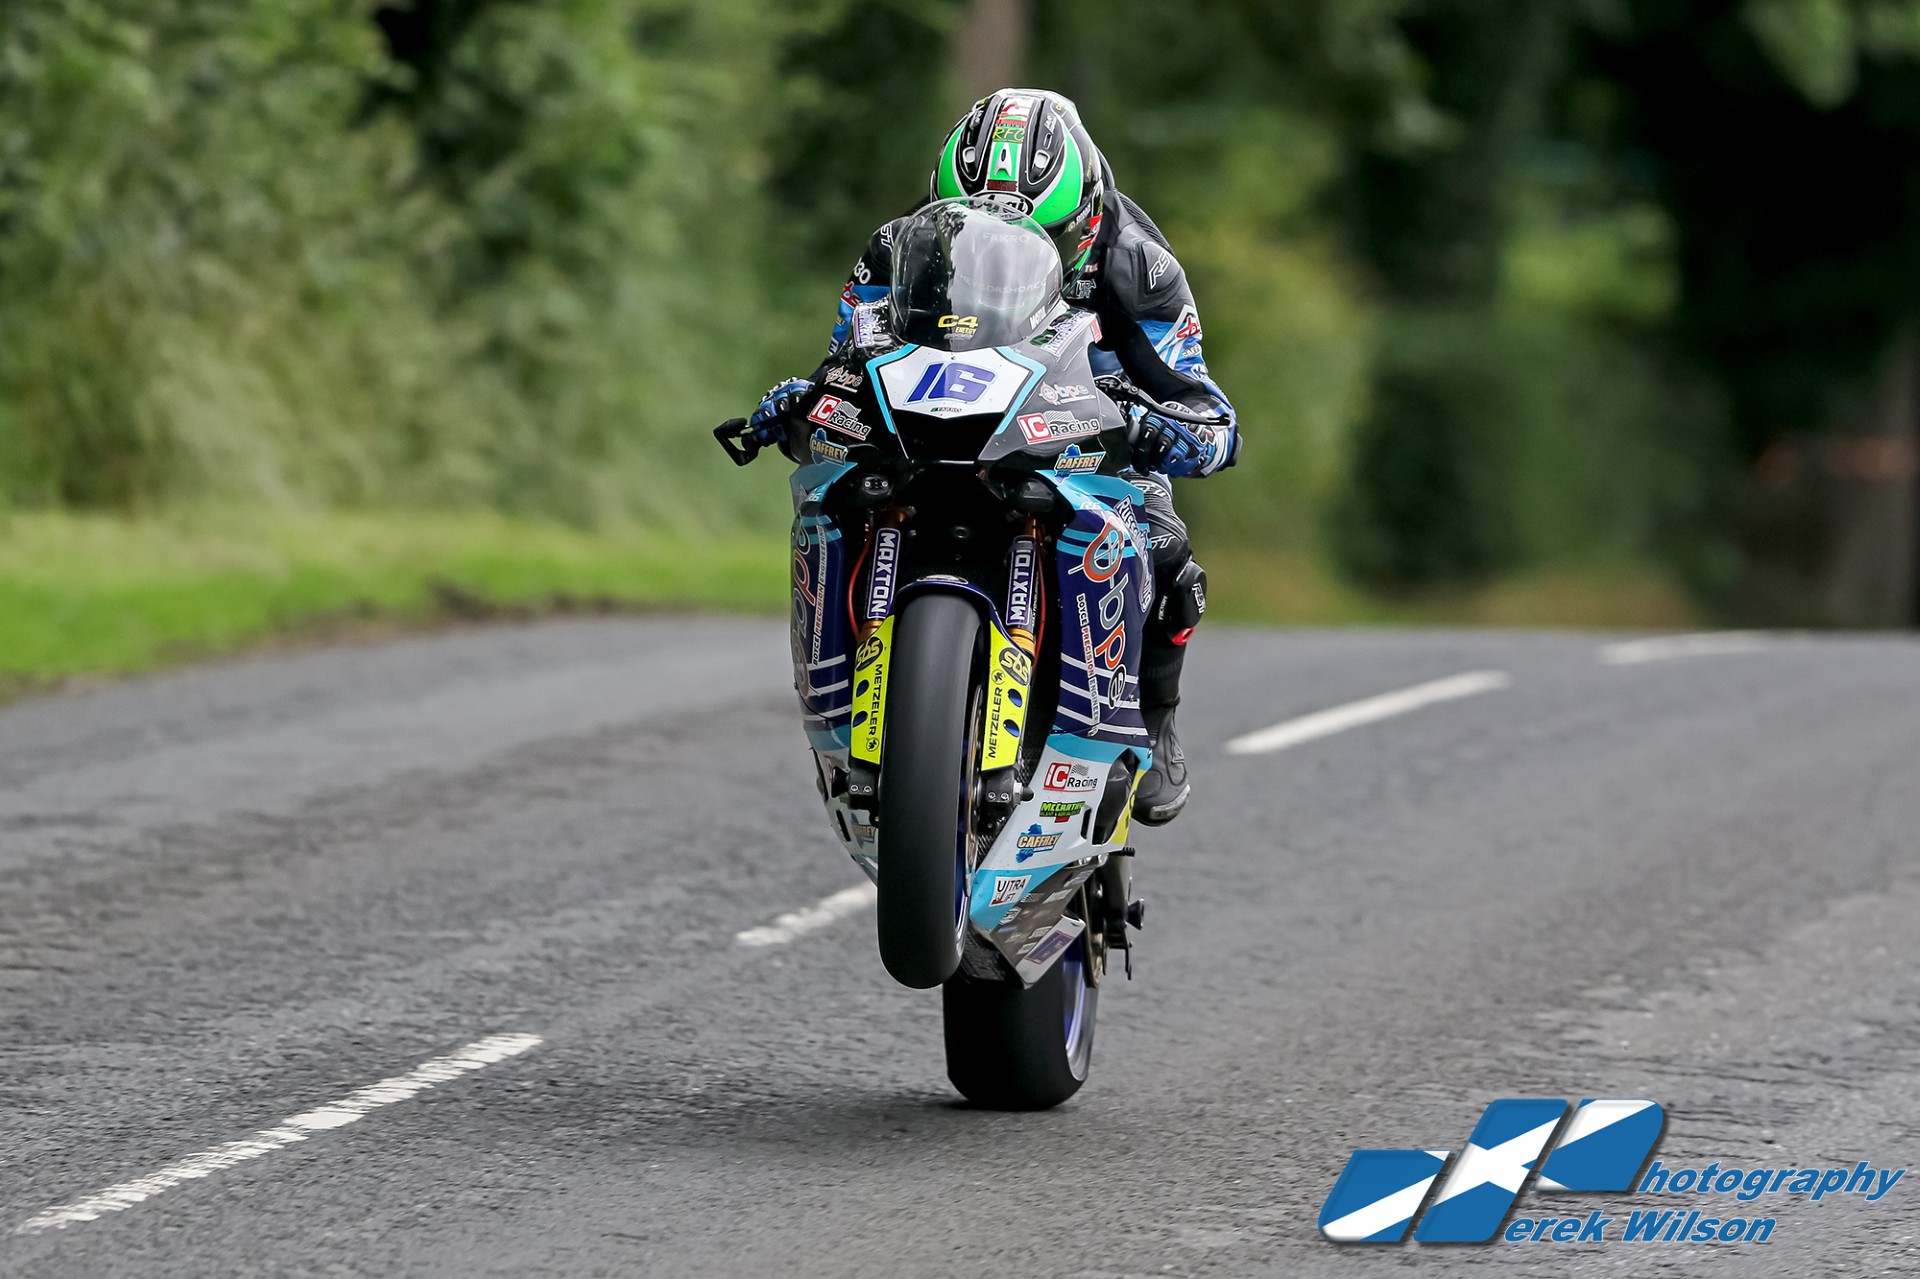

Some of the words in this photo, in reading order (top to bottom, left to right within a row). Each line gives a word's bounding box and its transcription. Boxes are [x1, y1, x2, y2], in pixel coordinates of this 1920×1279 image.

[992, 127, 1025, 140] RFC
[938, 315, 979, 328] C4
[904, 362, 996, 404] 16
[812, 397, 838, 420] IC
[828, 412, 872, 437] Racing
[1019, 416, 1050, 439] IC
[1049, 419, 1099, 436] Racing
[810, 439, 846, 461] CAFFREY
[1057, 456, 1102, 470] CAFFREY
[818, 526, 828, 585] ENGINEERING
[870, 532, 896, 614] MAXTON
[814, 586, 824, 636] PRECISION
[1077, 594, 1088, 625] BOYCE
[1082, 627, 1096, 677] PRECISION
[868, 663, 883, 736] METZELER
[988, 686, 1003, 759] METZELER
[1044, 764, 1069, 788] IC
[1067, 776, 1098, 789] Racing
[1018, 834, 1061, 848] CAFFREY
